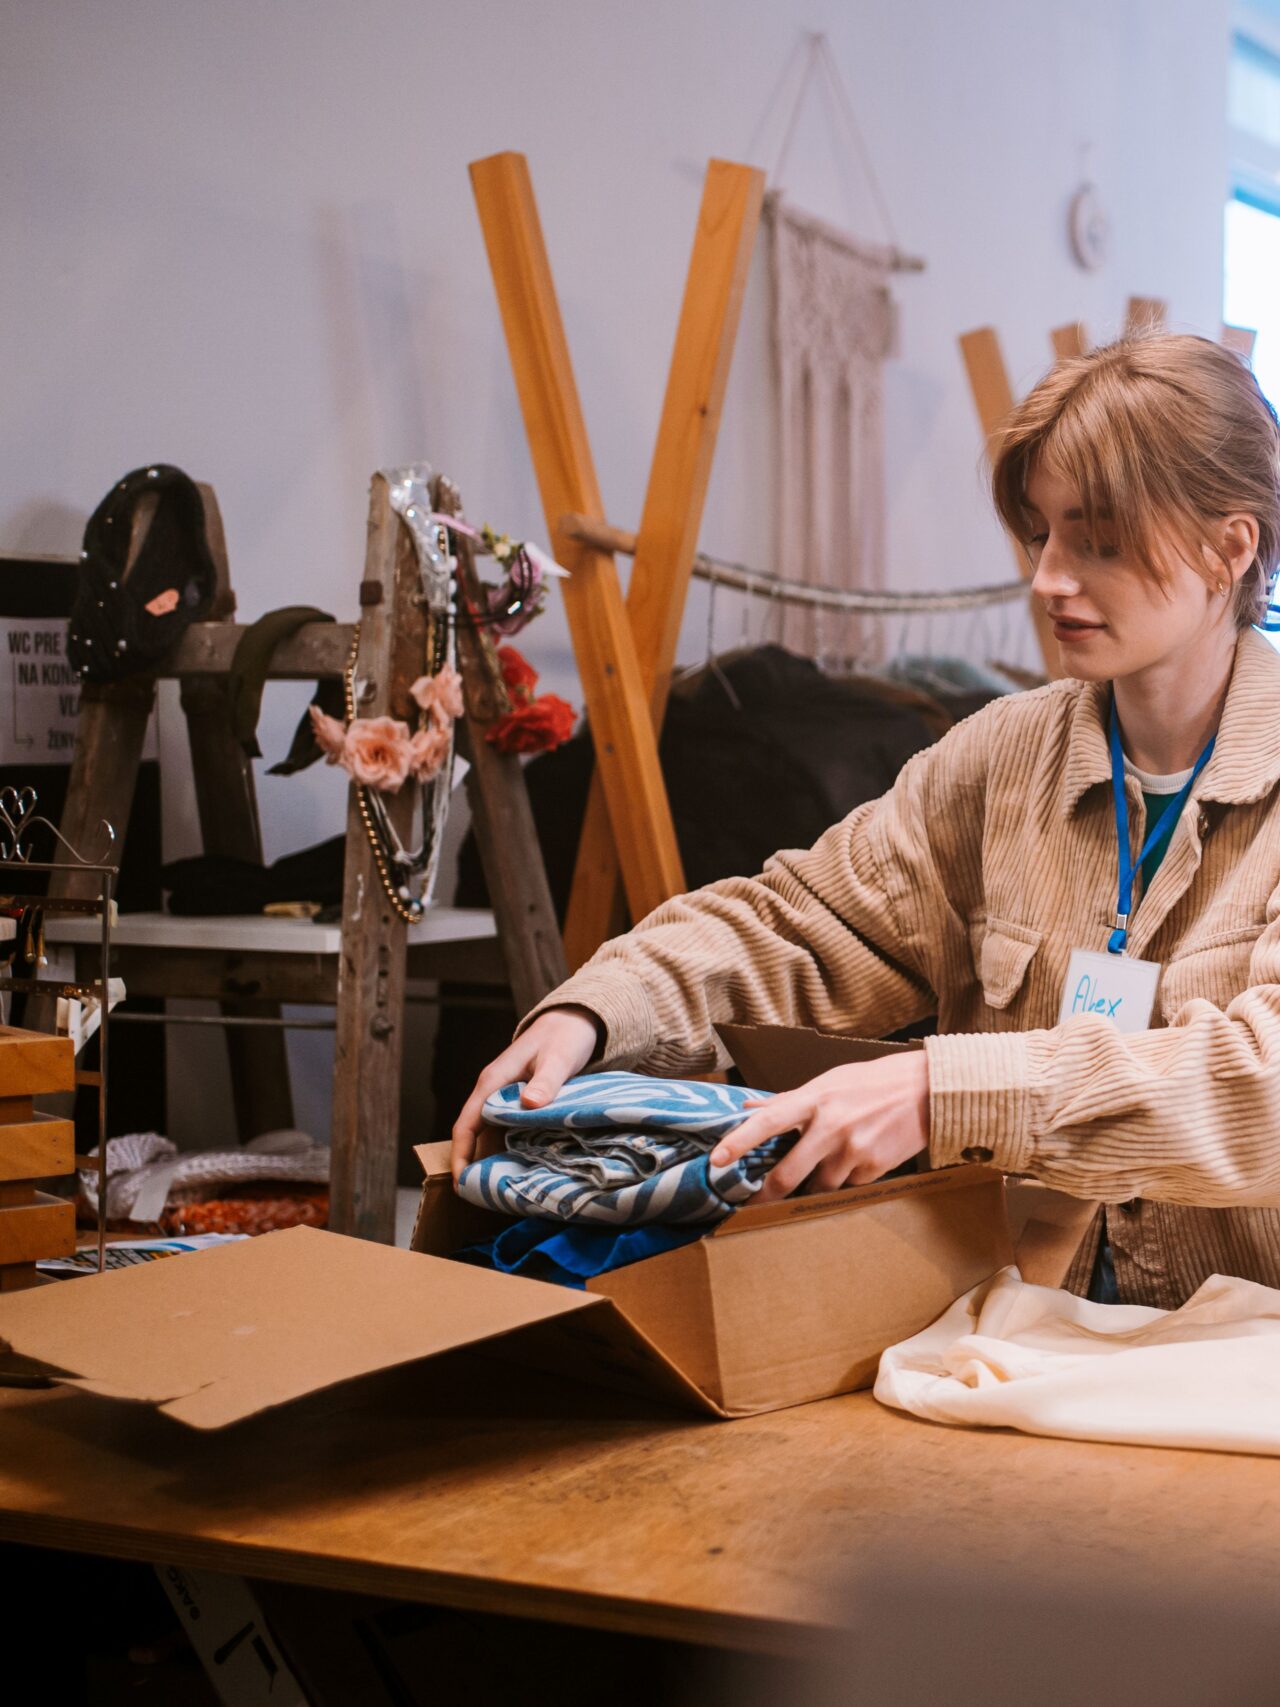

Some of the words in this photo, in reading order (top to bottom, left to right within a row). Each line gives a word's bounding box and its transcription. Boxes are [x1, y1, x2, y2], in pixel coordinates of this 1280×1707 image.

[8, 631, 31, 655] WC
[34, 632, 61, 656] PRE
[18, 663, 39, 685] NA
[1071, 974, 1122, 1017] Alex
